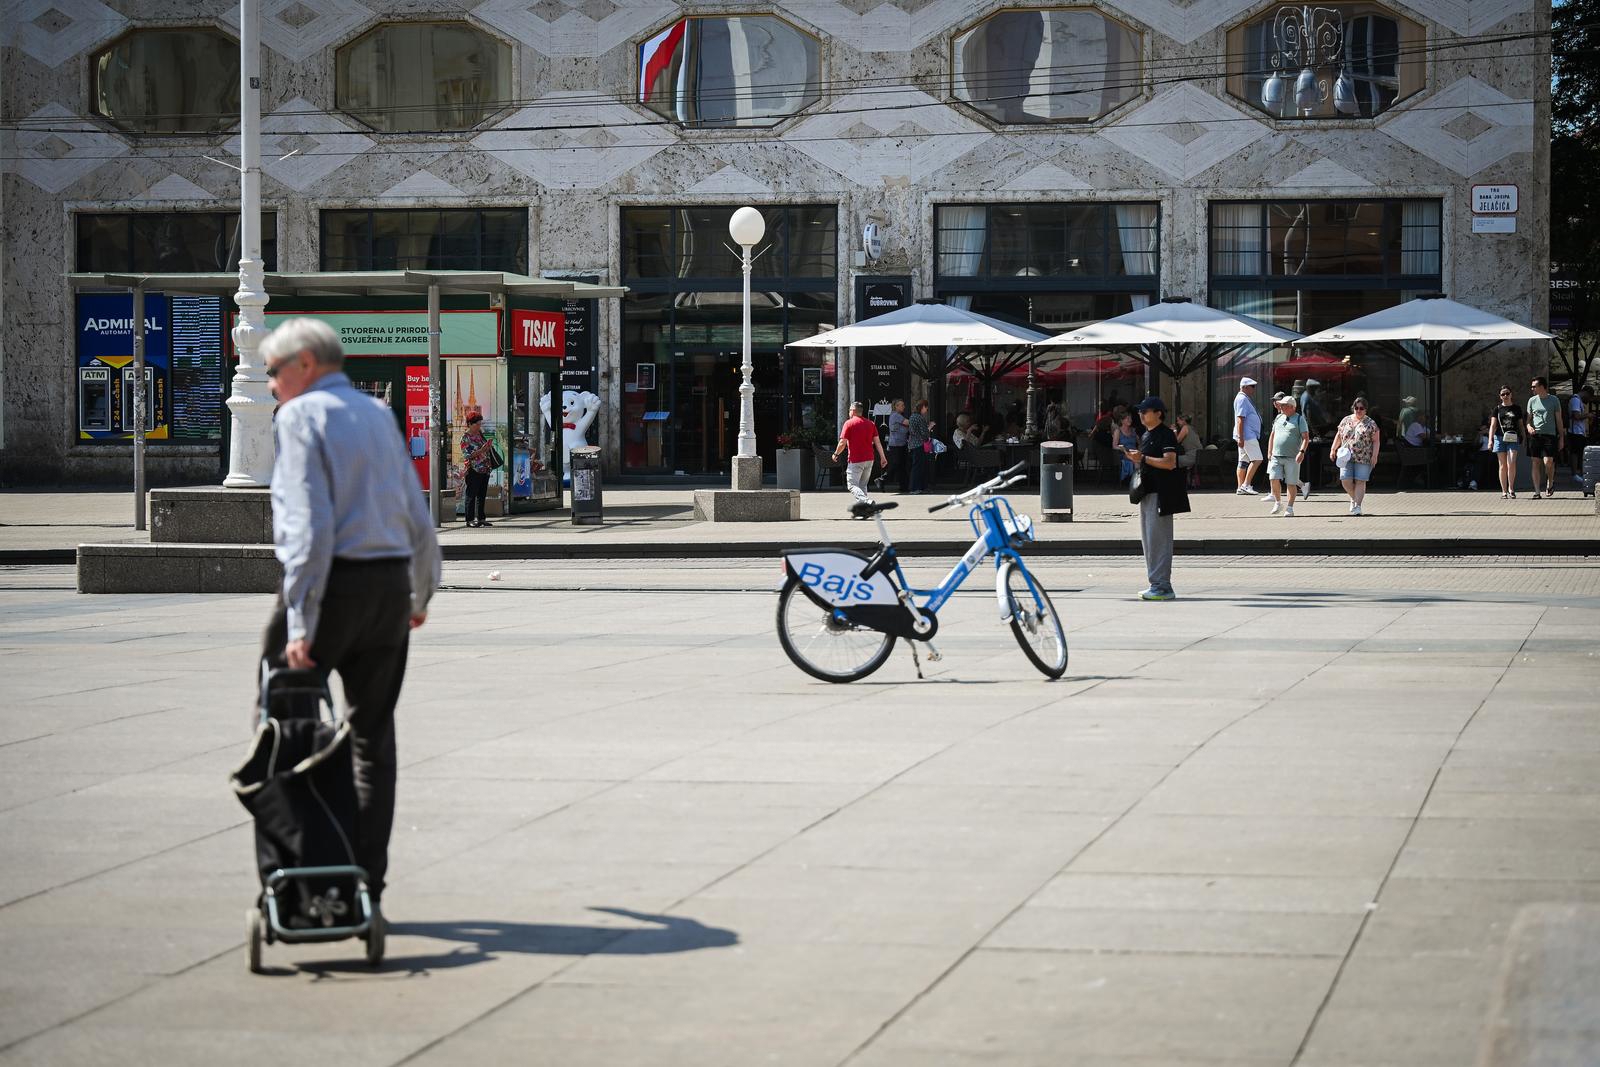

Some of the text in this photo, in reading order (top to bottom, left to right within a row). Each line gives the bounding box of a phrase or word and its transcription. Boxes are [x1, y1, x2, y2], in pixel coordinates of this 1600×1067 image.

[522, 318, 556, 349] TISAK
[341, 335, 430, 344] OSVJEŽENJE ZAGREB
[84, 371, 106, 379] ATM
[407, 375, 420, 383] Buy
[113, 378, 121, 399] cash
[113, 410, 121, 421] 24
[157, 410, 164, 421] 24
[800, 562, 874, 602] Bajs
